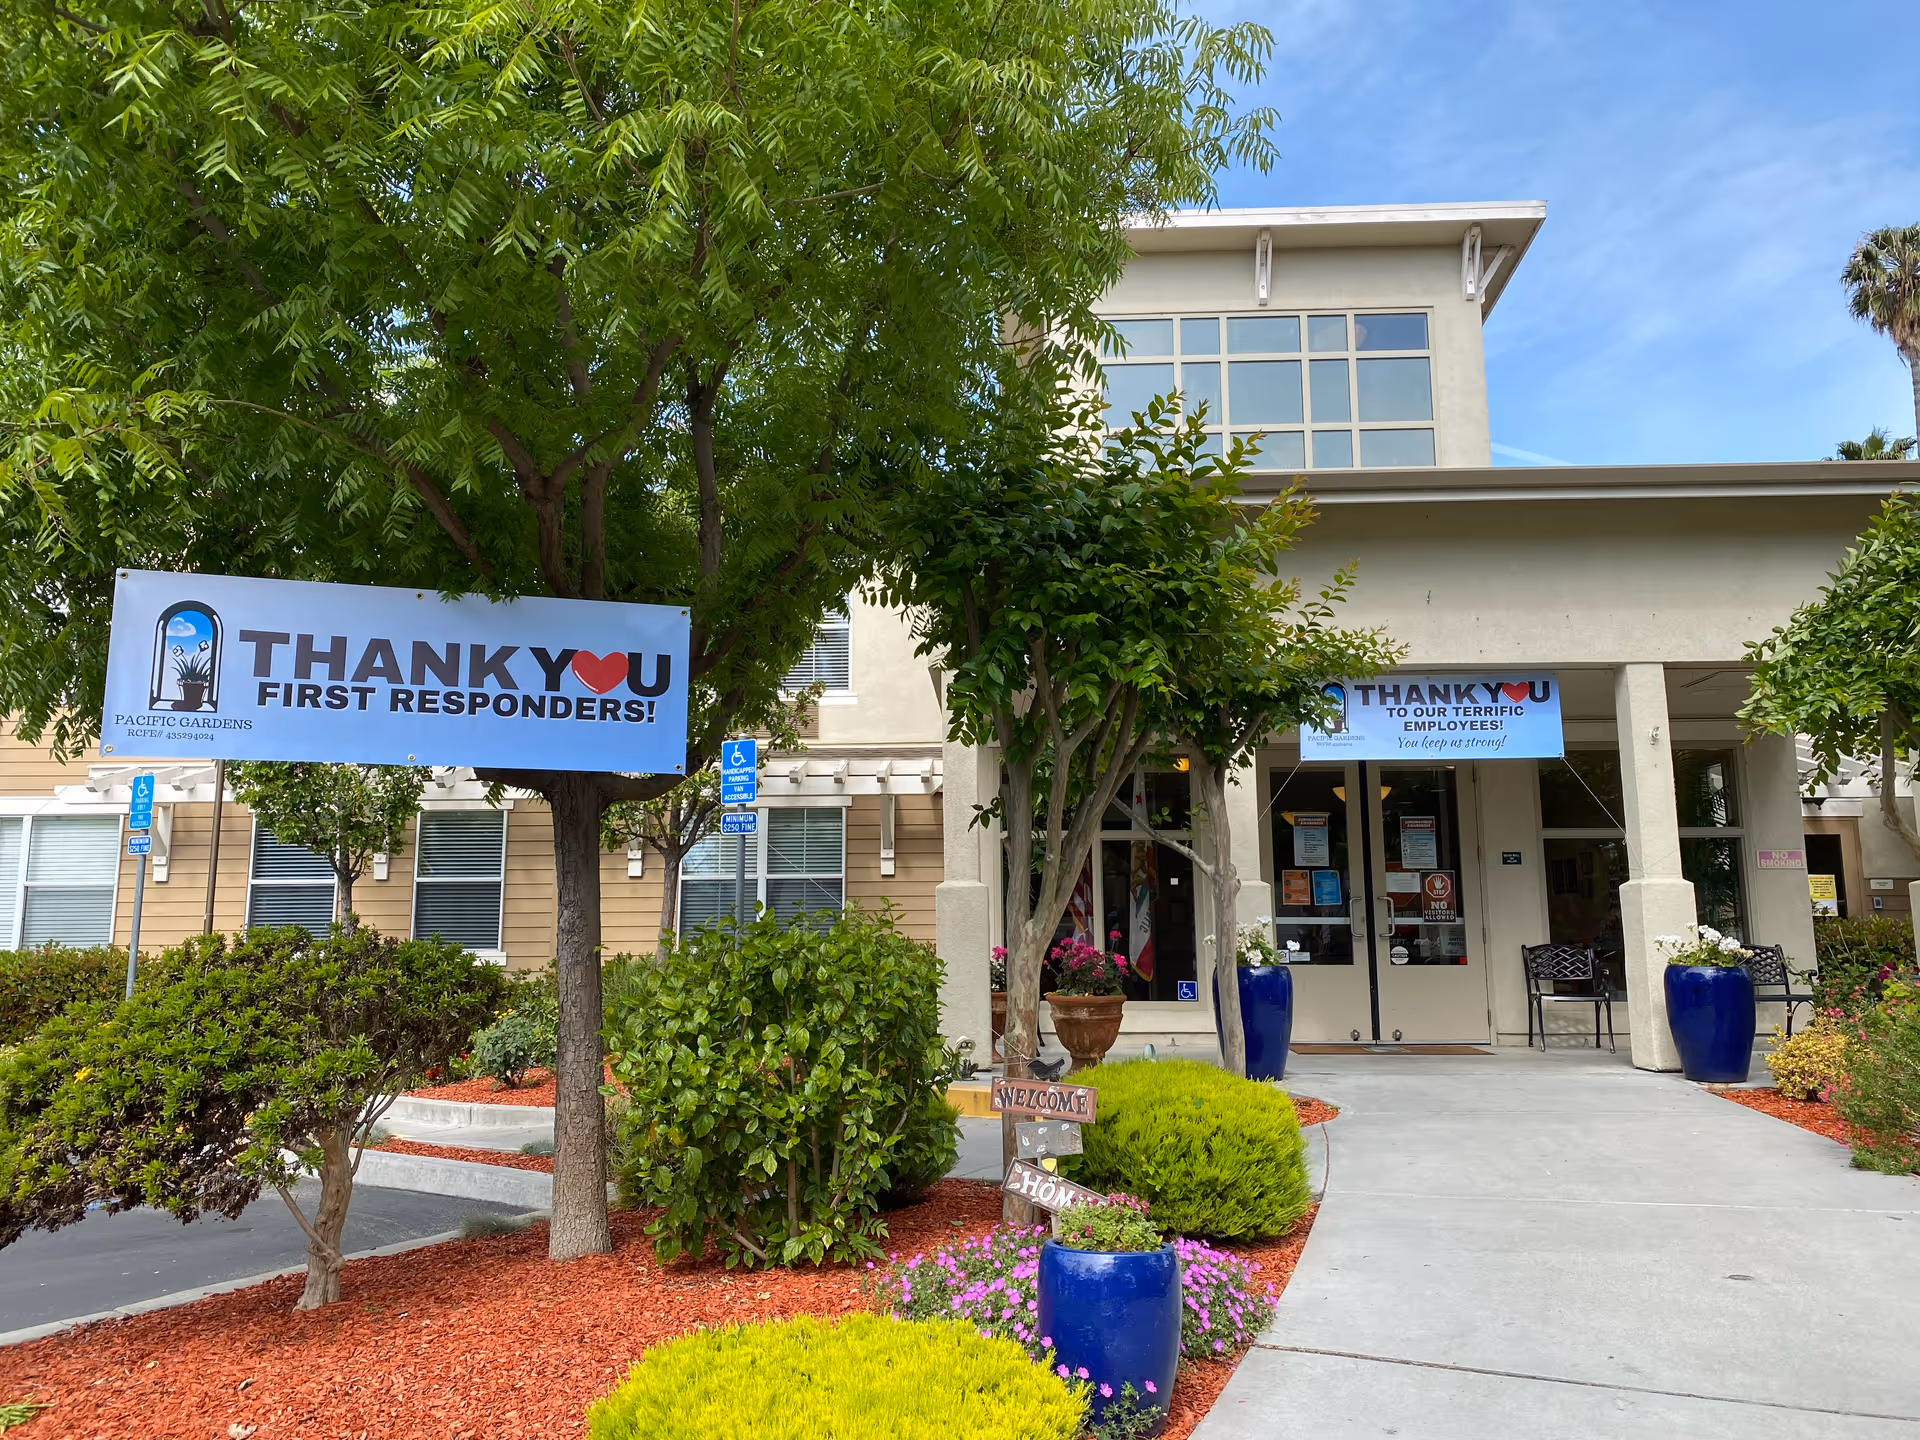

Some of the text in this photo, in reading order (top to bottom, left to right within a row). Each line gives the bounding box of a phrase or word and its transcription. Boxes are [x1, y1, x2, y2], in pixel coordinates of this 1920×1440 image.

[239, 629, 521, 690] THANK
[1354, 684, 1478, 705] THANK
[257, 682, 657, 724] FIRST RESPONDERS!
[1386, 706, 1525, 718] TO OUR TERRIFIC
[114, 714, 253, 731] PACIFIC GARDENS
[1403, 720, 1504, 732] EMPLOYEES!
[1398, 735, 1507, 751] You keep us strong!
[725, 814, 754, 822] MINIMUM
[723, 823, 756, 832] $250 FINE
[1772, 851, 1789, 859] NO
[1760, 859, 1802, 867] SMOKING
[1431, 901, 1448, 909] NO
[997, 1086, 1090, 1115] WELCOME
[1020, 1171, 1093, 1209] HOM
